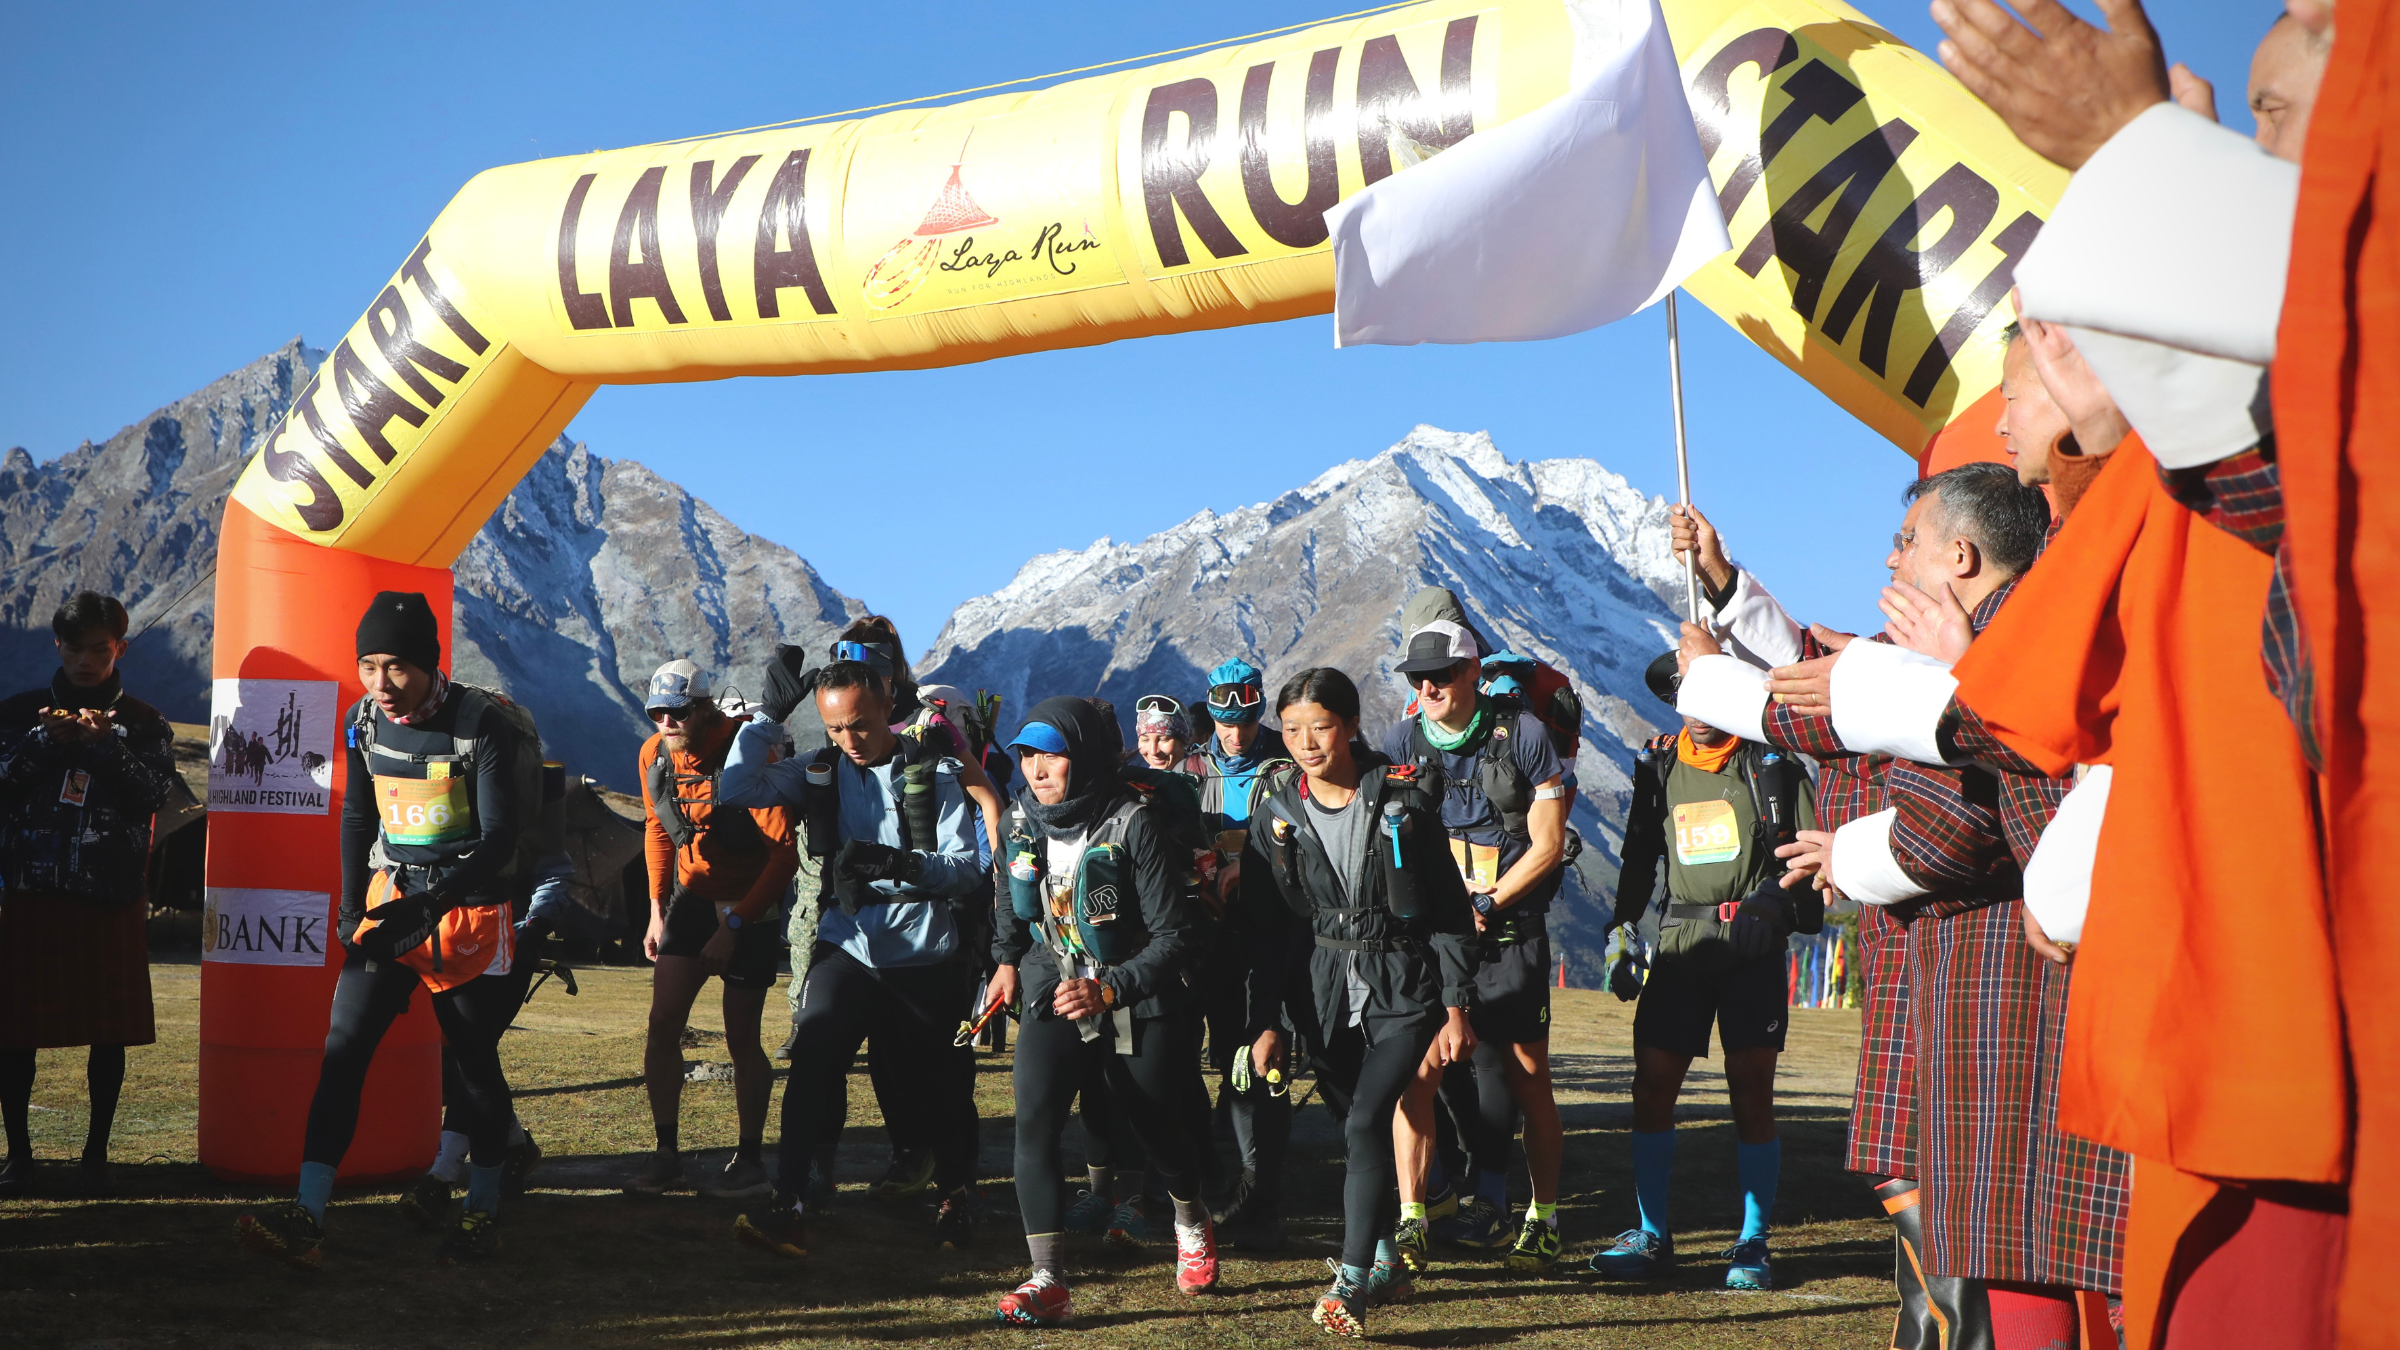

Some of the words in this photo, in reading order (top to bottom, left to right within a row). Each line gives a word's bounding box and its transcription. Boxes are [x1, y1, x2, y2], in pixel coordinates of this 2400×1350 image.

[1141, 15, 1479, 268] RUN
[558, 148, 838, 331] LAYA
[1691, 27, 2046, 410] START
[940, 236, 1022, 278] Laya
[1031, 222, 1101, 275] Run
[948, 286, 967, 294] RUN
[972, 283, 991, 291] FOR
[997, 274, 1057, 287] HIGHLANDS
[264, 235, 491, 532] START
[212, 789, 257, 805] HIGHLAND
[260, 790, 325, 808] FESTIVAL
[388, 803, 450, 827] 166
[1677, 823, 1730, 848] 159
[216, 913, 325, 954] BANK
